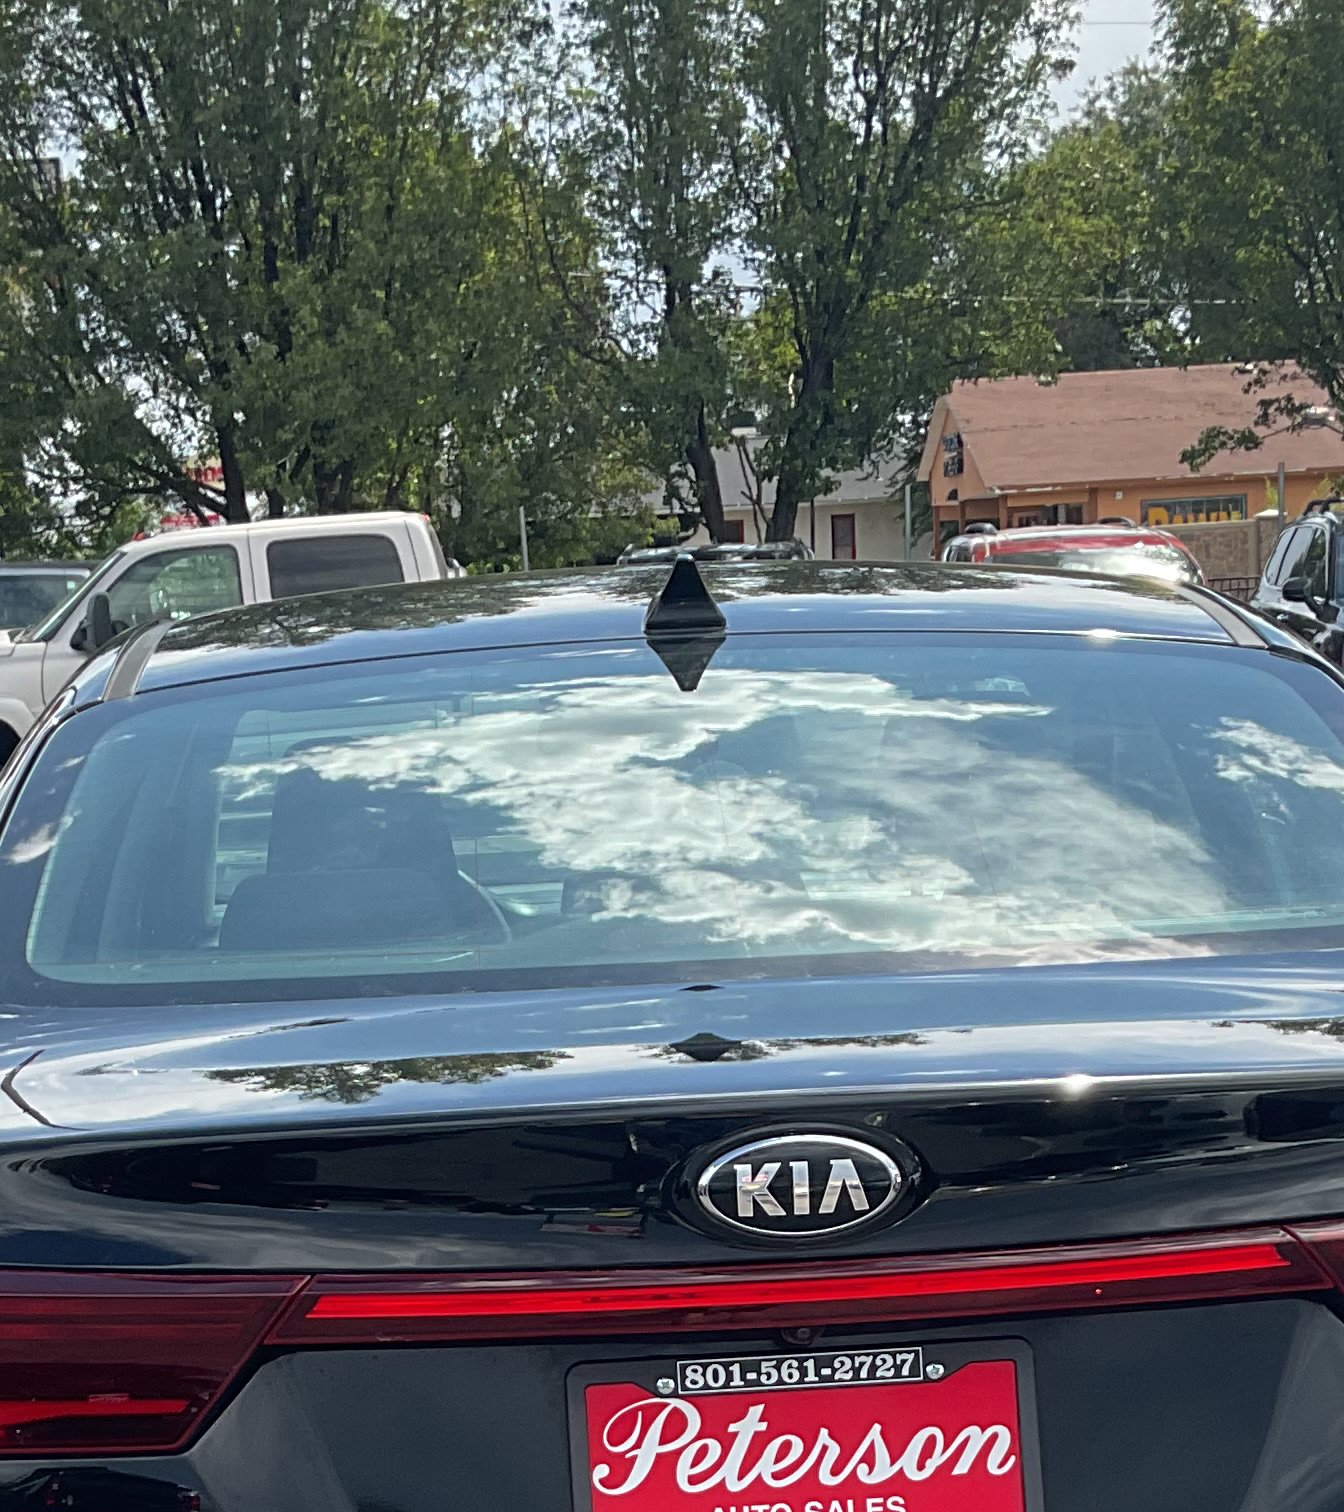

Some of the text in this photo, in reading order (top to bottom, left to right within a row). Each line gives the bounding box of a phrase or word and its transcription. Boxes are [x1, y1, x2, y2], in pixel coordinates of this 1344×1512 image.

[733, 1159, 870, 1217] KIA
[684, 1351, 916, 1389] 801-561-2727
[593, 1397, 1017, 1496] Peterson
